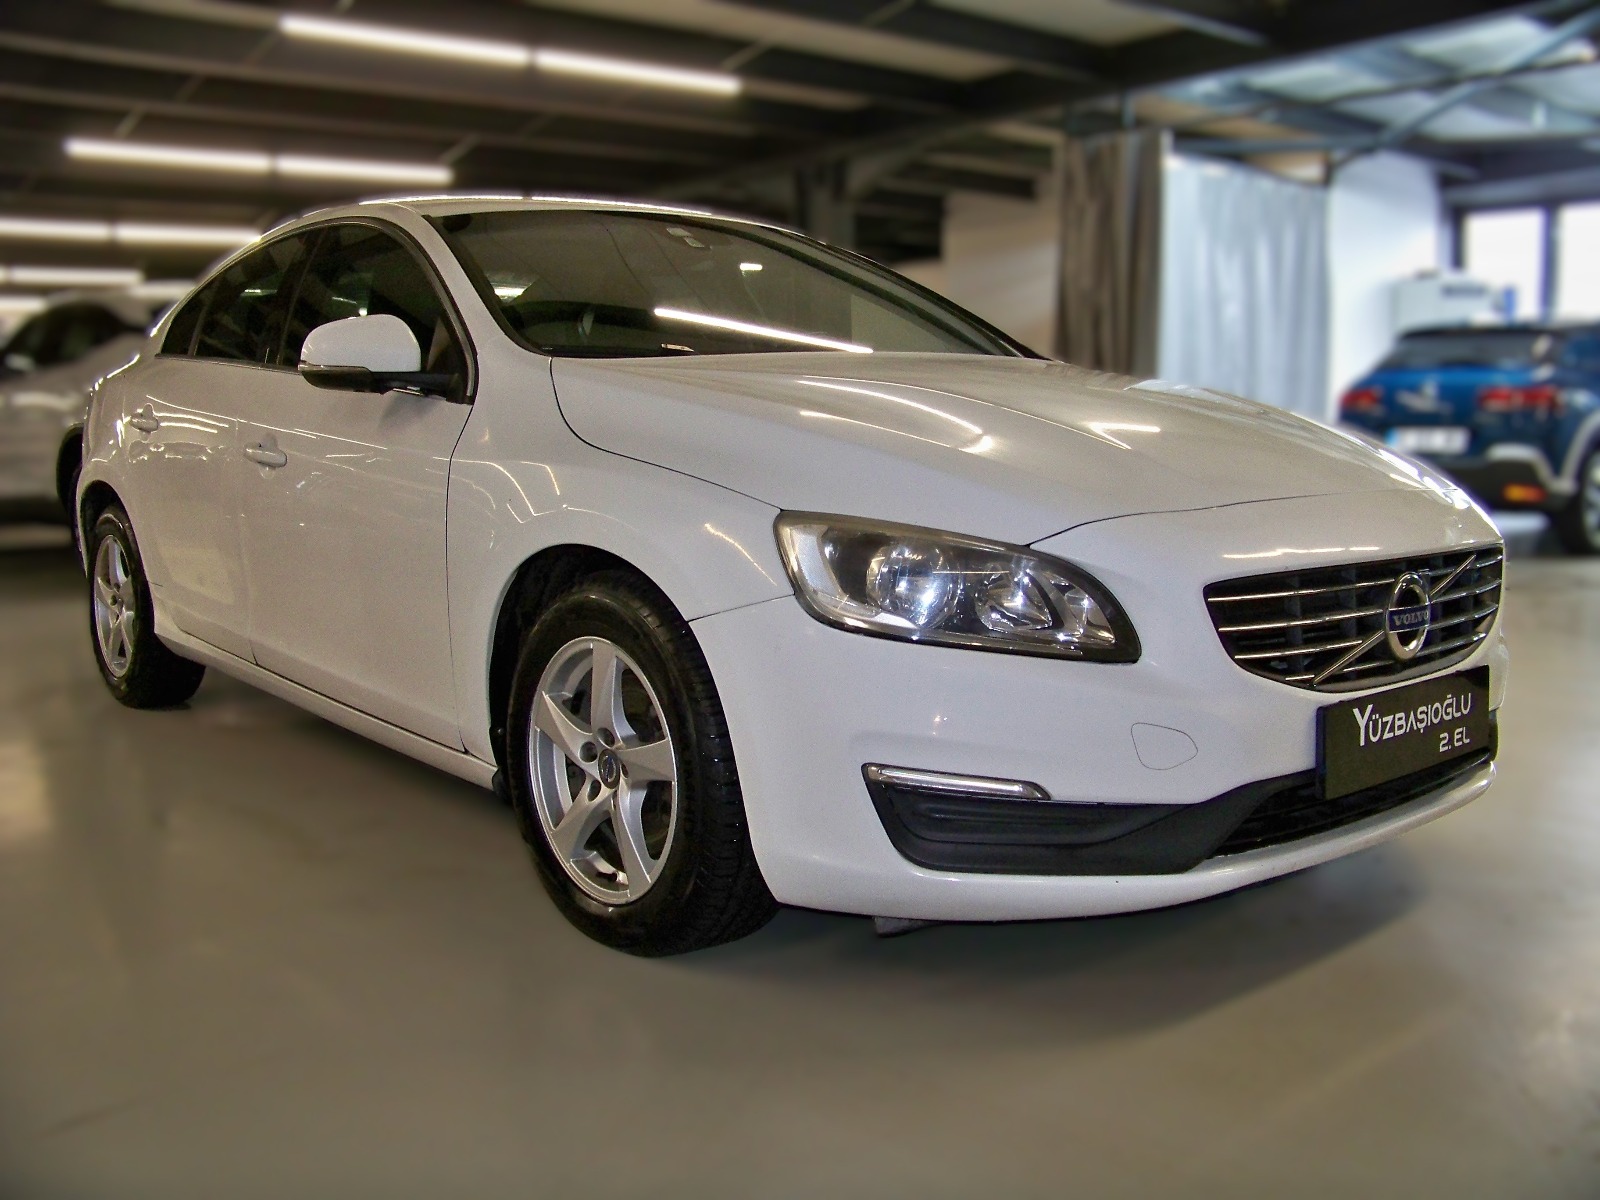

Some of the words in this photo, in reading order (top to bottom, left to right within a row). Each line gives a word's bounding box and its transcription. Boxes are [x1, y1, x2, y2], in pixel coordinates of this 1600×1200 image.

[1393, 611, 1429, 626] VOLVO
[1353, 693, 1471, 747] YÜZBAŞIOĞLU
[1439, 733, 1452, 753] 2.
[1454, 726, 1470, 747] EL
